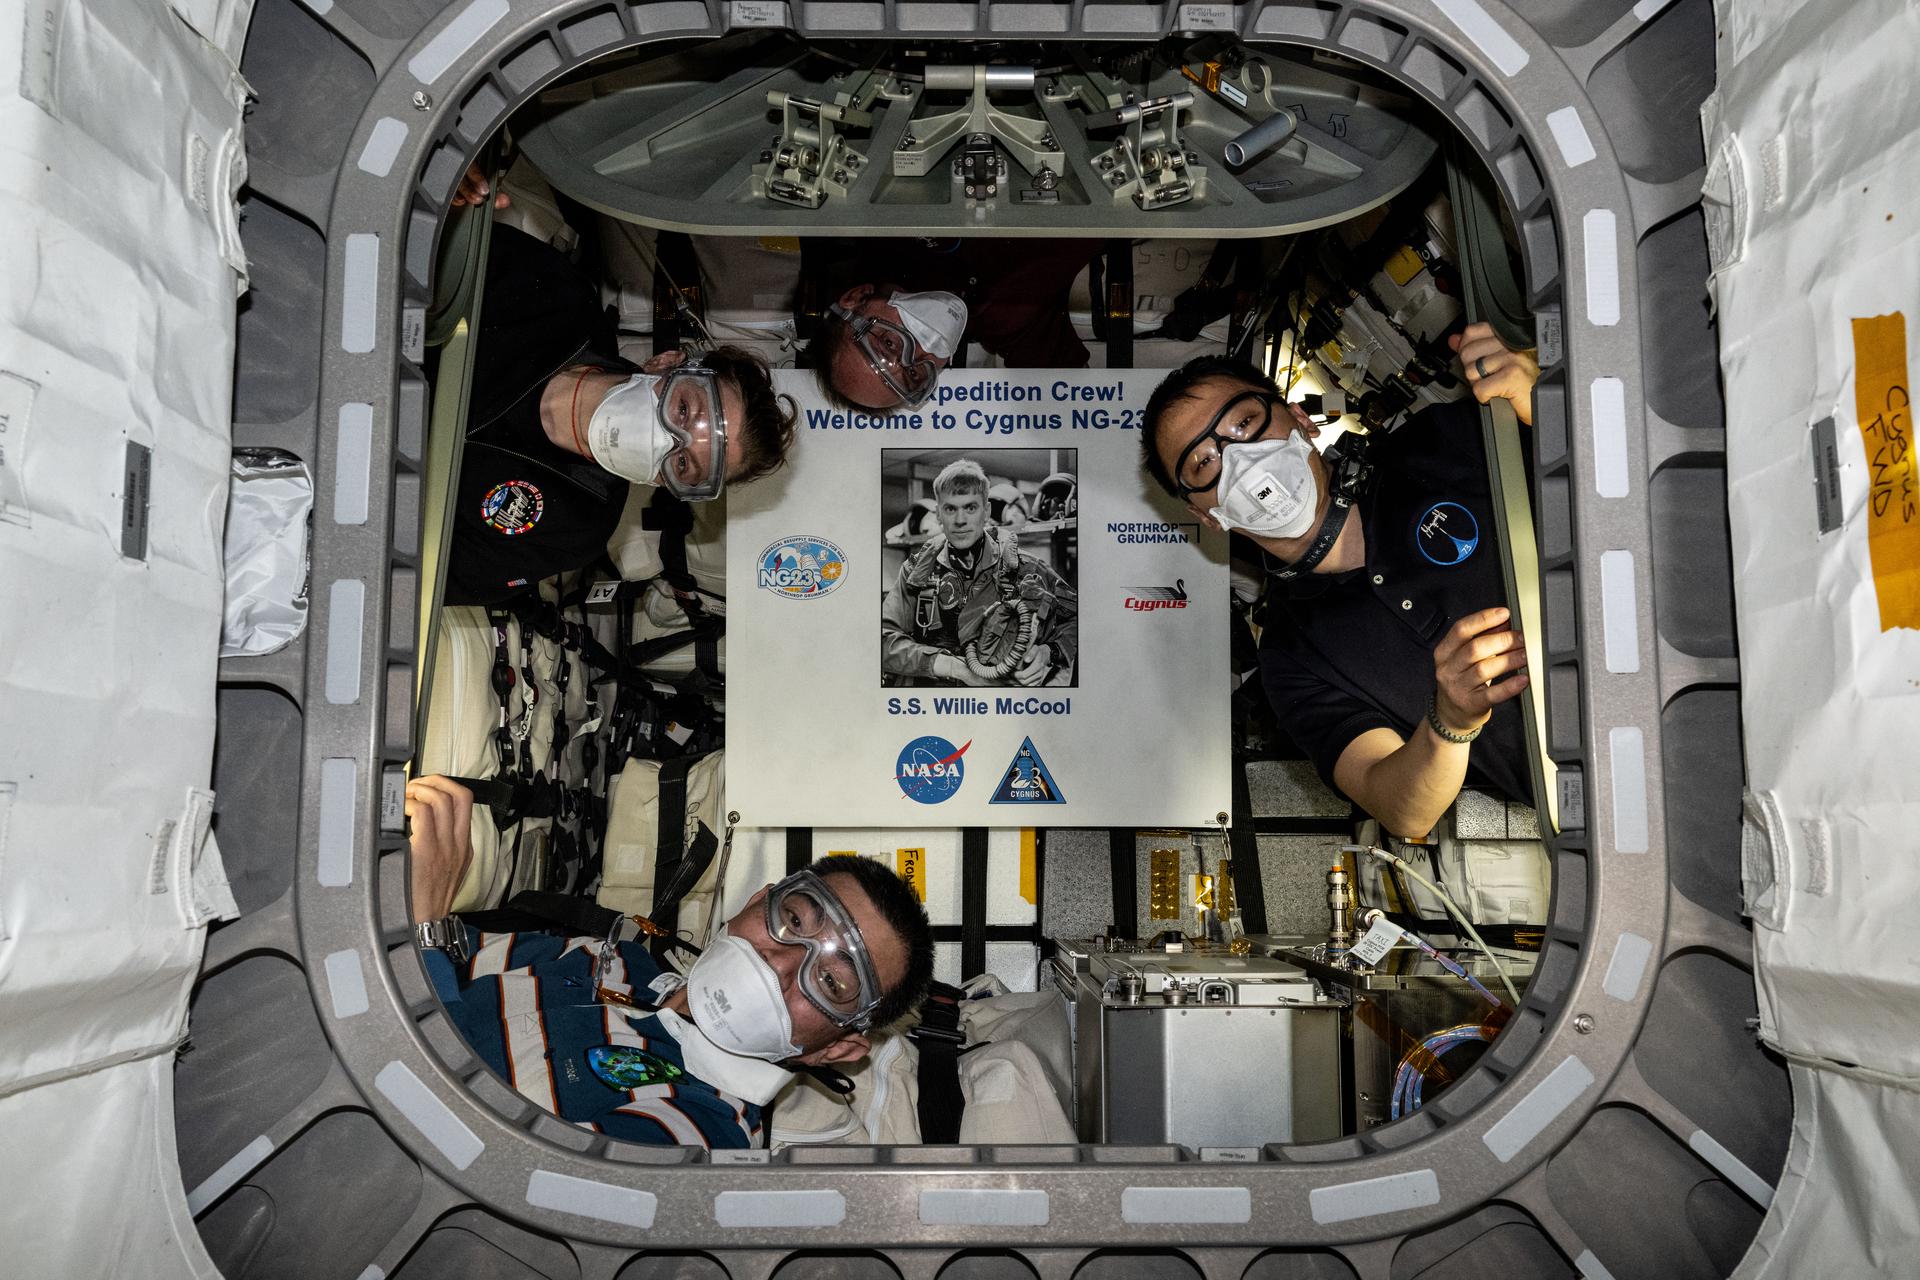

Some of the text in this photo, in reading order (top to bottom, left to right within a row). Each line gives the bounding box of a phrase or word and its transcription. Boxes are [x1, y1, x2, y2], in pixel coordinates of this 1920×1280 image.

[1051, 381, 1124, 401] Crew!
[806, 409, 923, 429] Welcome
[931, 410, 956, 430] to
[965, 409, 1063, 435] Cygnus
[609, 427, 620, 449] 3M
[1865, 413, 1893, 517] FWD
[1257, 486, 1273, 500] 3M
[1107, 523, 1178, 533] NORTHROP
[808, 537, 829, 547] SERVICES
[1117, 534, 1189, 544] GRUMMAN
[1461, 543, 1473, 555] 73
[592, 587, 615, 599] A1
[777, 589, 829, 598] NORTHROP GRUMMAN
[1124, 597, 1188, 611] Cygnus
[887, 697, 1071, 715] S.S. Willie McCool
[1020, 749, 1031, 757] NG
[902, 763, 961, 777] NASA
[1010, 790, 1041, 798] CYGNUS
[714, 989, 733, 1013] 3M
